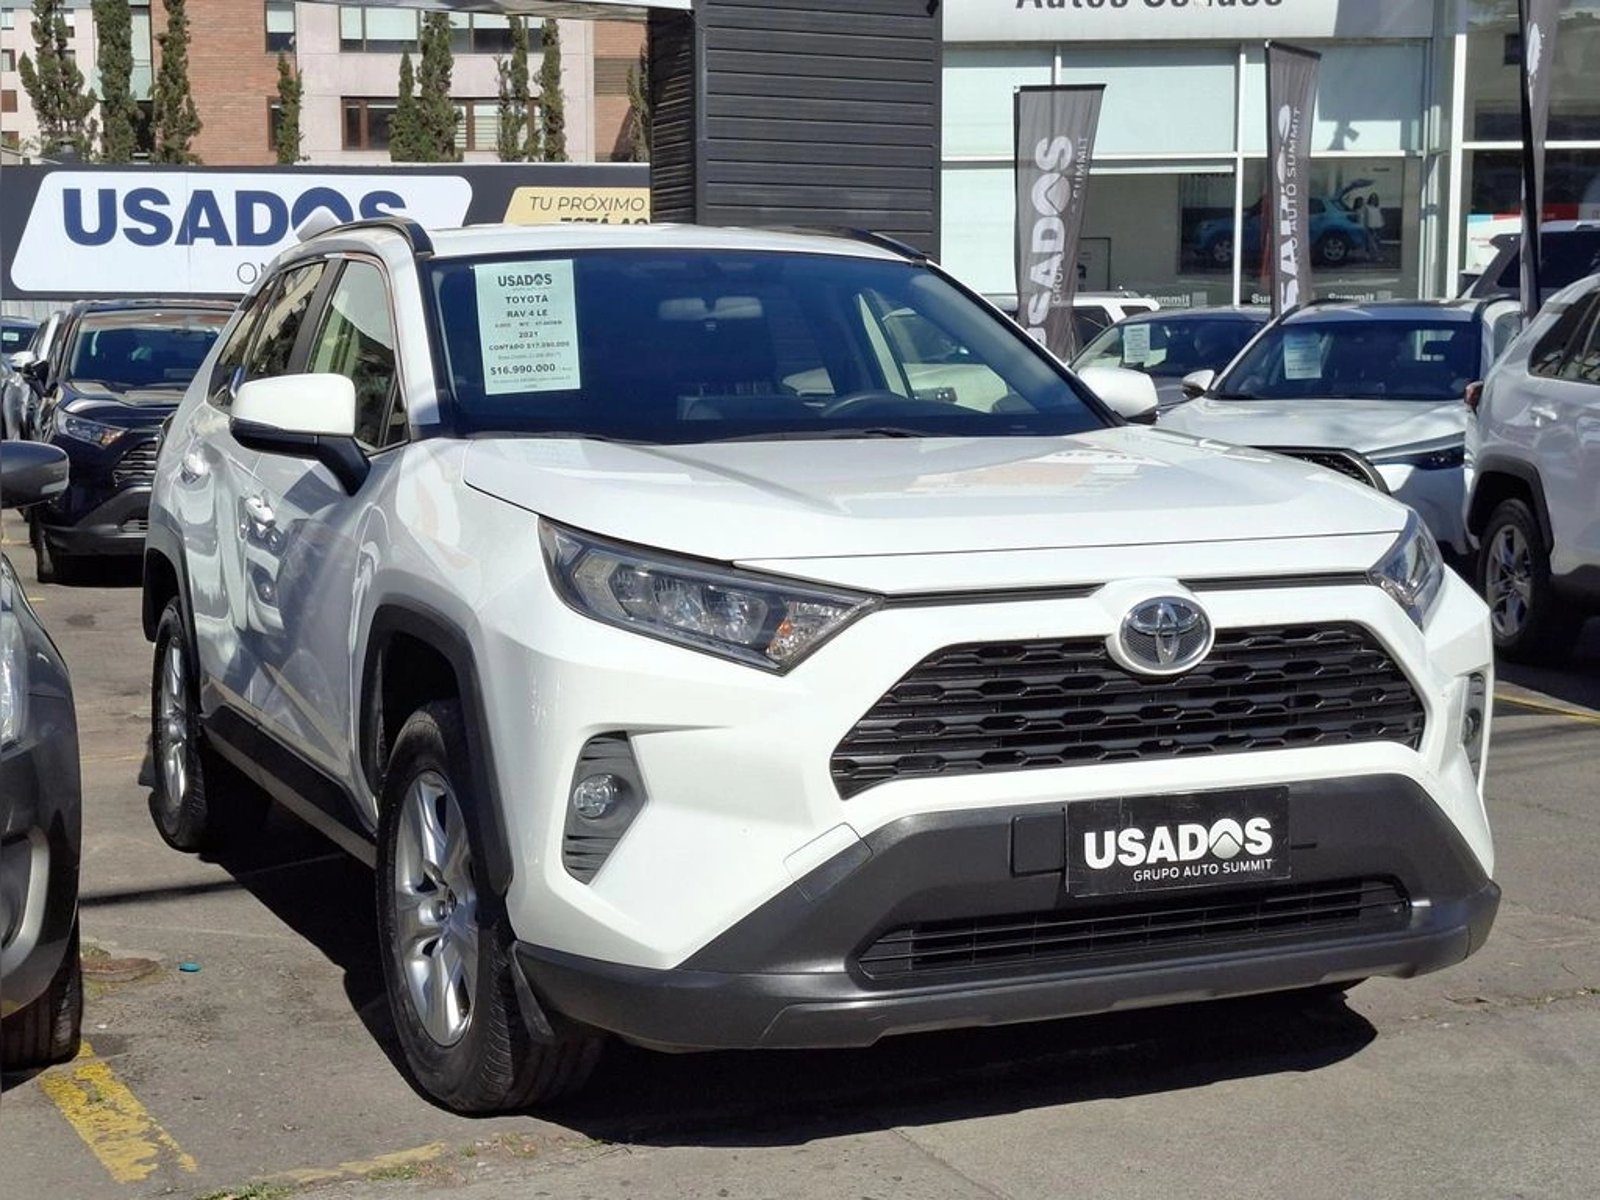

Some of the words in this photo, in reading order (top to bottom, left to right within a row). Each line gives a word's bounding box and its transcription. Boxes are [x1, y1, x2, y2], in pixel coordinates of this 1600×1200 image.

[1287, 108, 1301, 178] SUMMIT
[530, 196, 553, 211] TU
[558, 193, 645, 211] PRÓXIMO
[498, 273, 552, 287] USADOS
[506, 295, 548, 304] TOYOTA
[1144, 294, 1190, 307] ummit
[507, 310, 526, 318] RAV
[537, 309, 548, 317] LE
[490, 363, 556, 376] $16.990.000
[1084, 817, 1273, 870] USADOS
[1133, 867, 1179, 882] GRUPO
[1183, 864, 1219, 877] AUTO
[1222, 858, 1273, 872] SUMMIT
